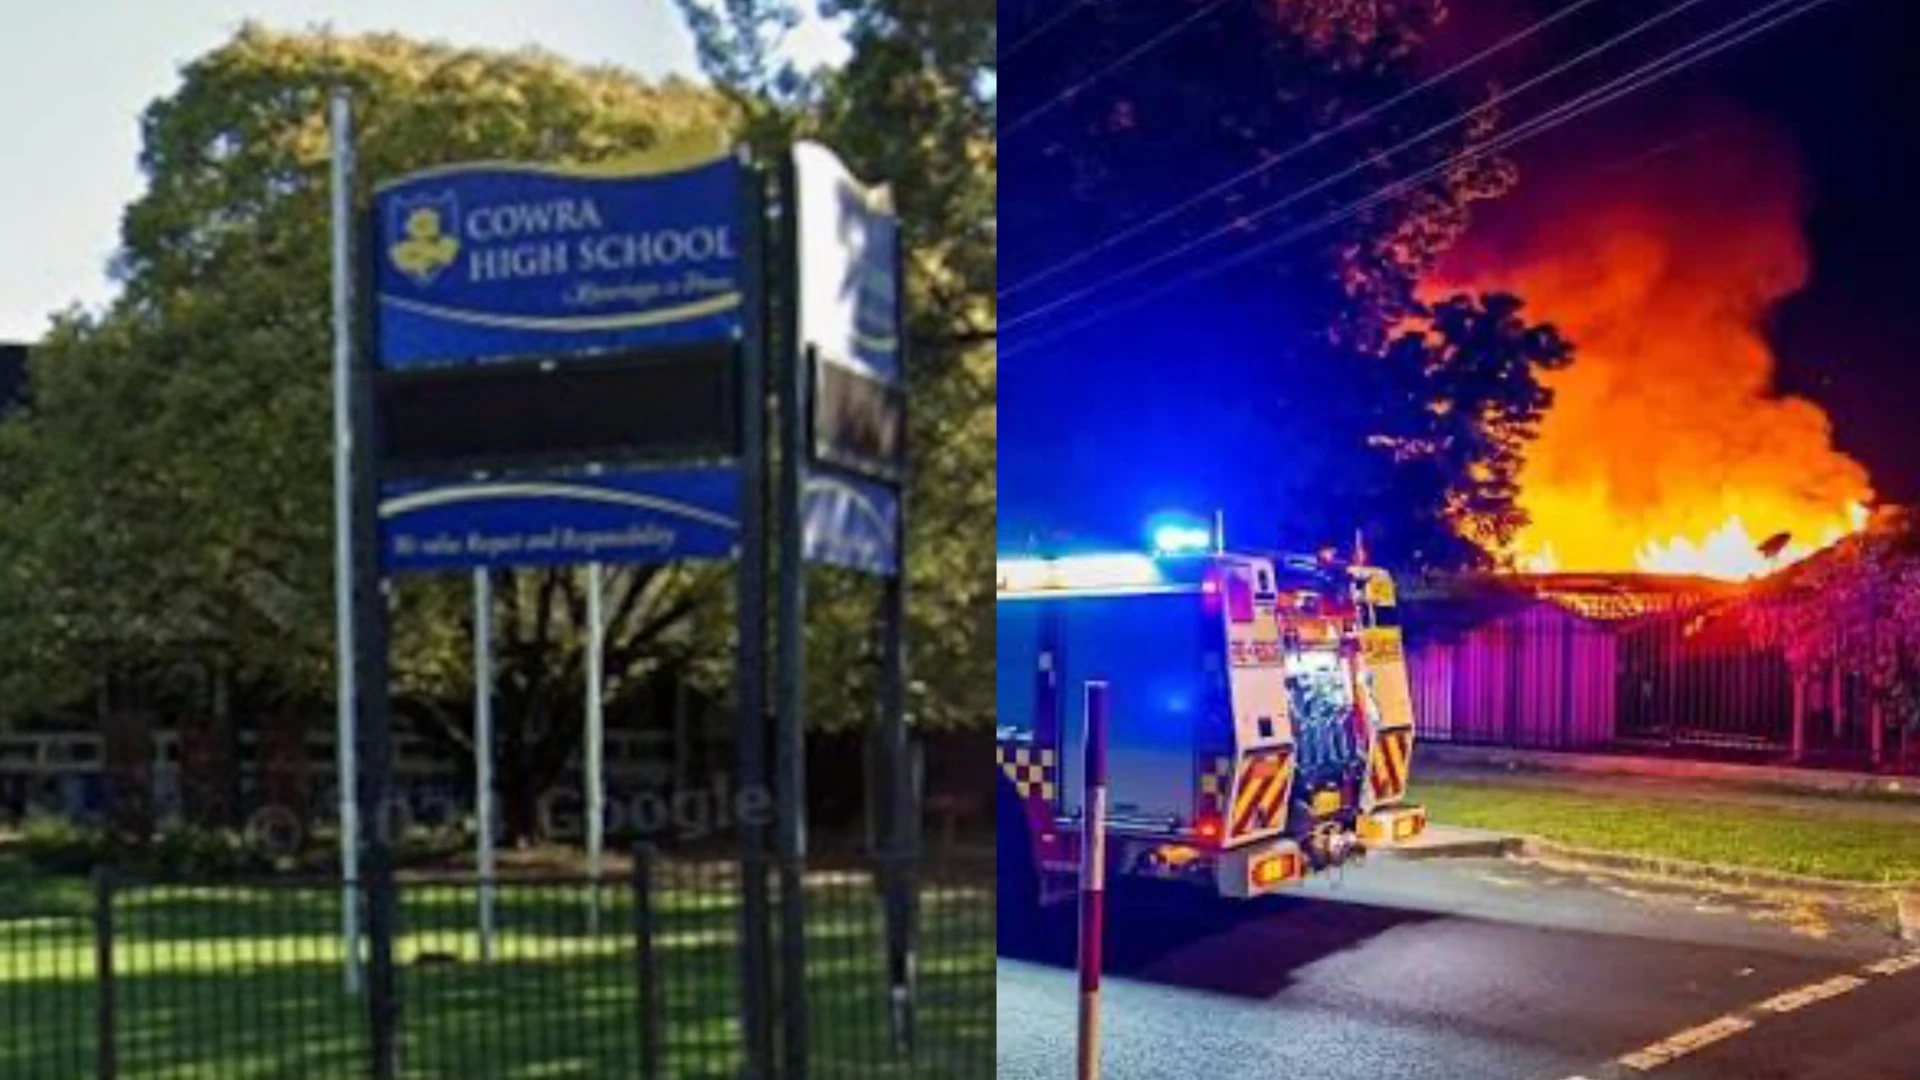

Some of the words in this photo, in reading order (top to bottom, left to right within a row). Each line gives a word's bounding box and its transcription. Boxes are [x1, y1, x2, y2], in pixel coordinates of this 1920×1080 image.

[465, 200, 602, 241] COWRA
[469, 243, 568, 282] HIGH
[576, 225, 736, 272] SCHOOL
[526, 525, 560, 551] and
